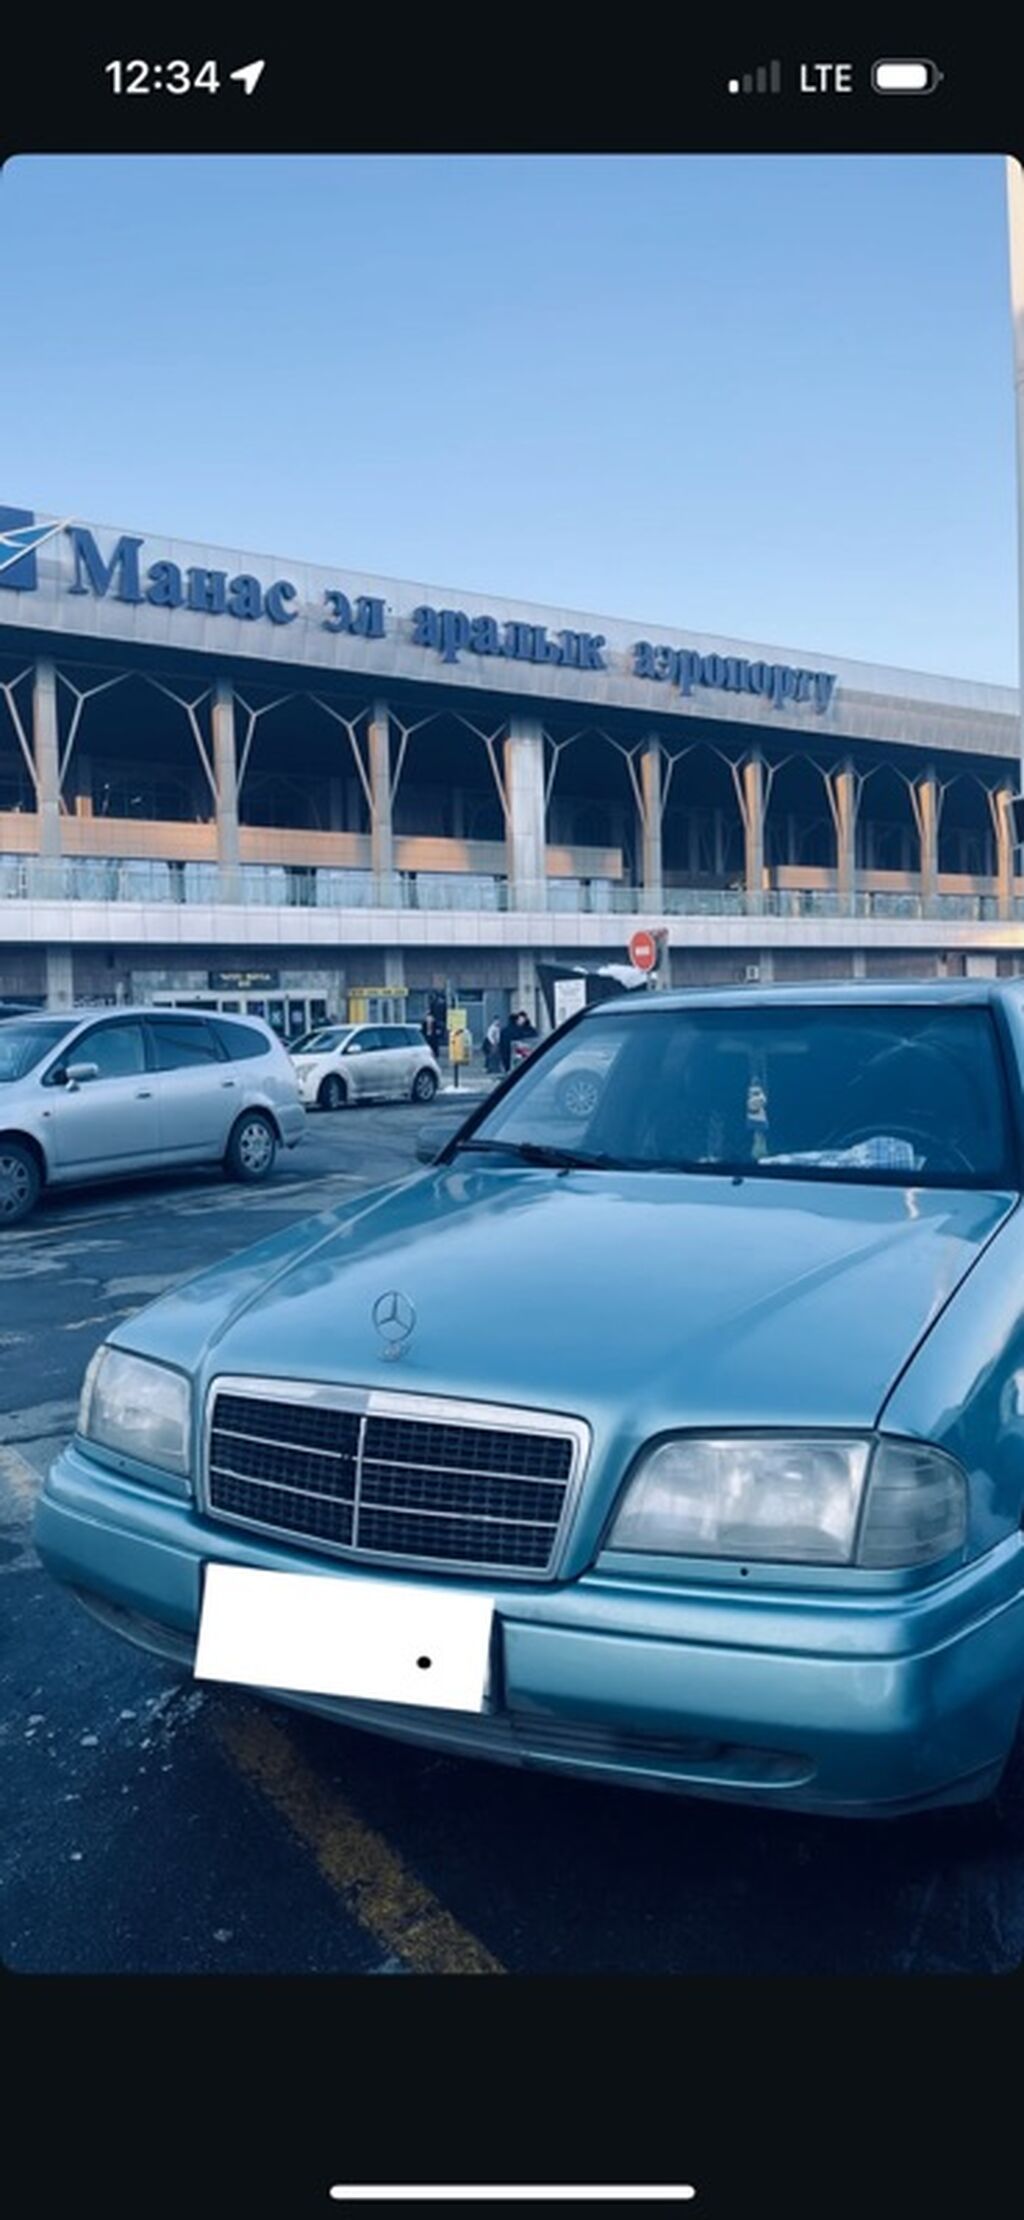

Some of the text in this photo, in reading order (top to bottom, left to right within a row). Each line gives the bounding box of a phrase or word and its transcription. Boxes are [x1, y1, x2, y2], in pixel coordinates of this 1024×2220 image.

[65, 525, 837, 715] Манас эл аралык аэропорту
